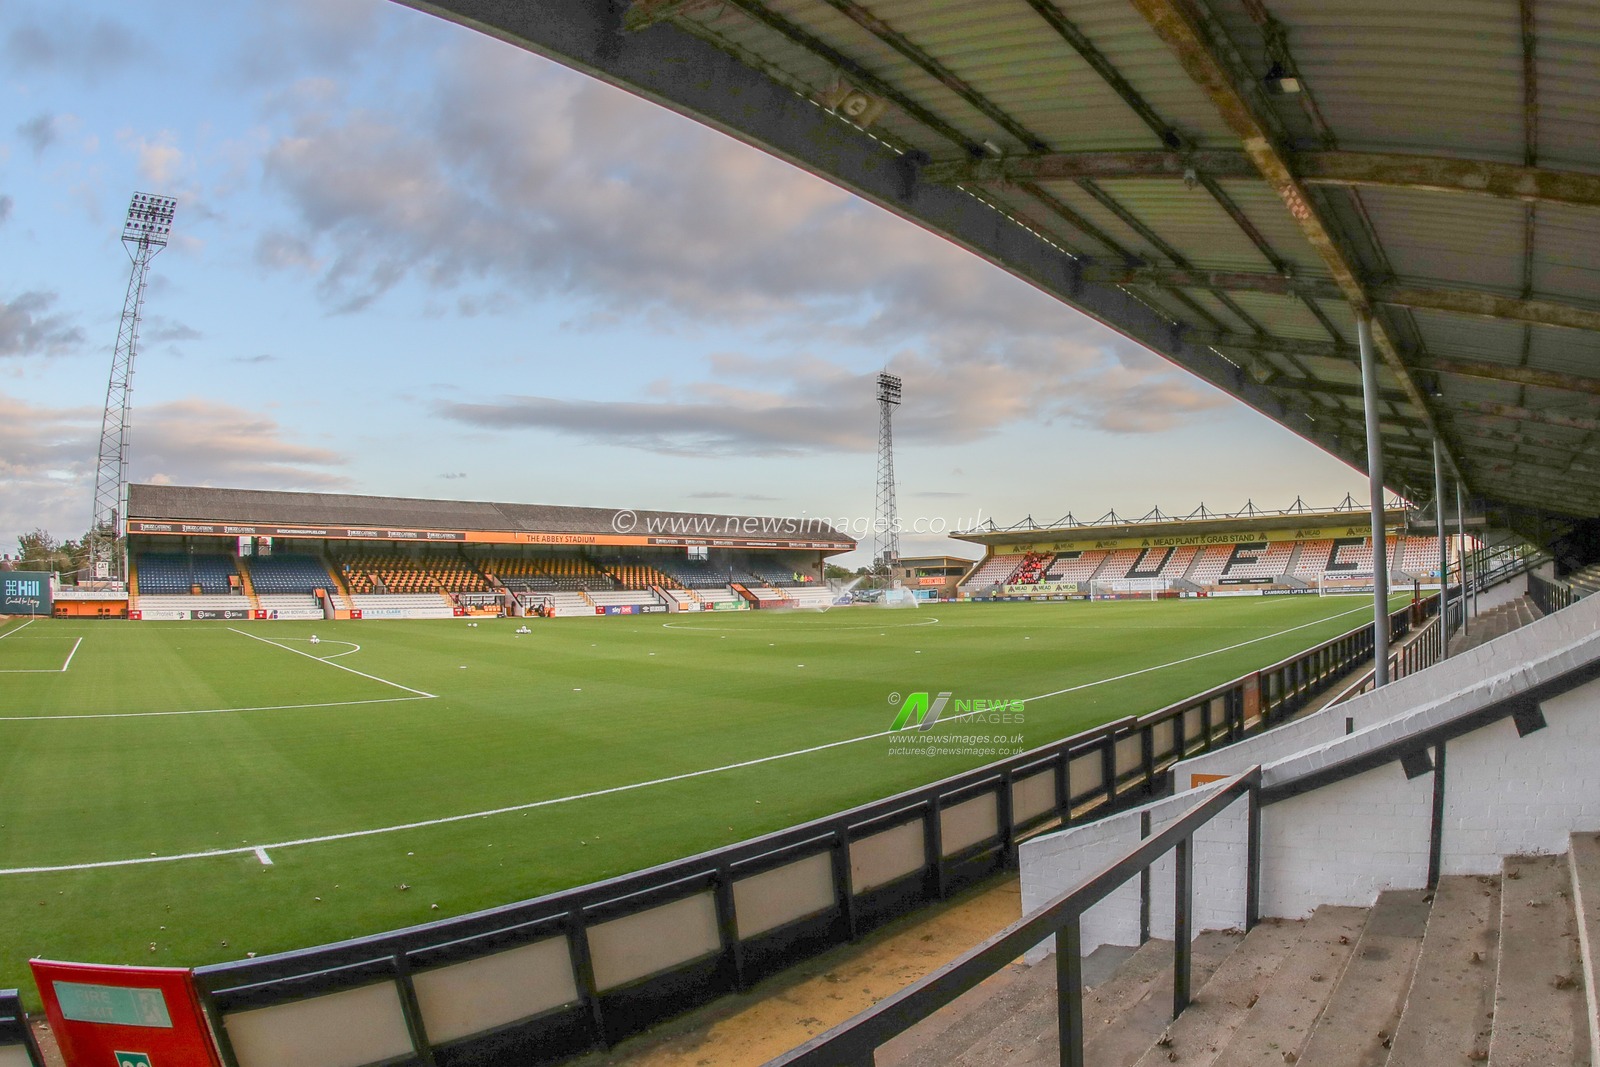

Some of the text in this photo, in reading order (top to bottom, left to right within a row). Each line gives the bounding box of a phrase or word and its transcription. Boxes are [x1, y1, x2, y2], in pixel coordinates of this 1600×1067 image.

[541, 535, 564, 543] ABBEY
[565, 536, 596, 544] STADIUM
[1153, 538, 1175, 546] MEAD
[1175, 537, 1199, 545] PLANT
[1206, 535, 1229, 544] GRAB
[1230, 534, 1255, 542] STAND
[18, 581, 39, 596] Hill
